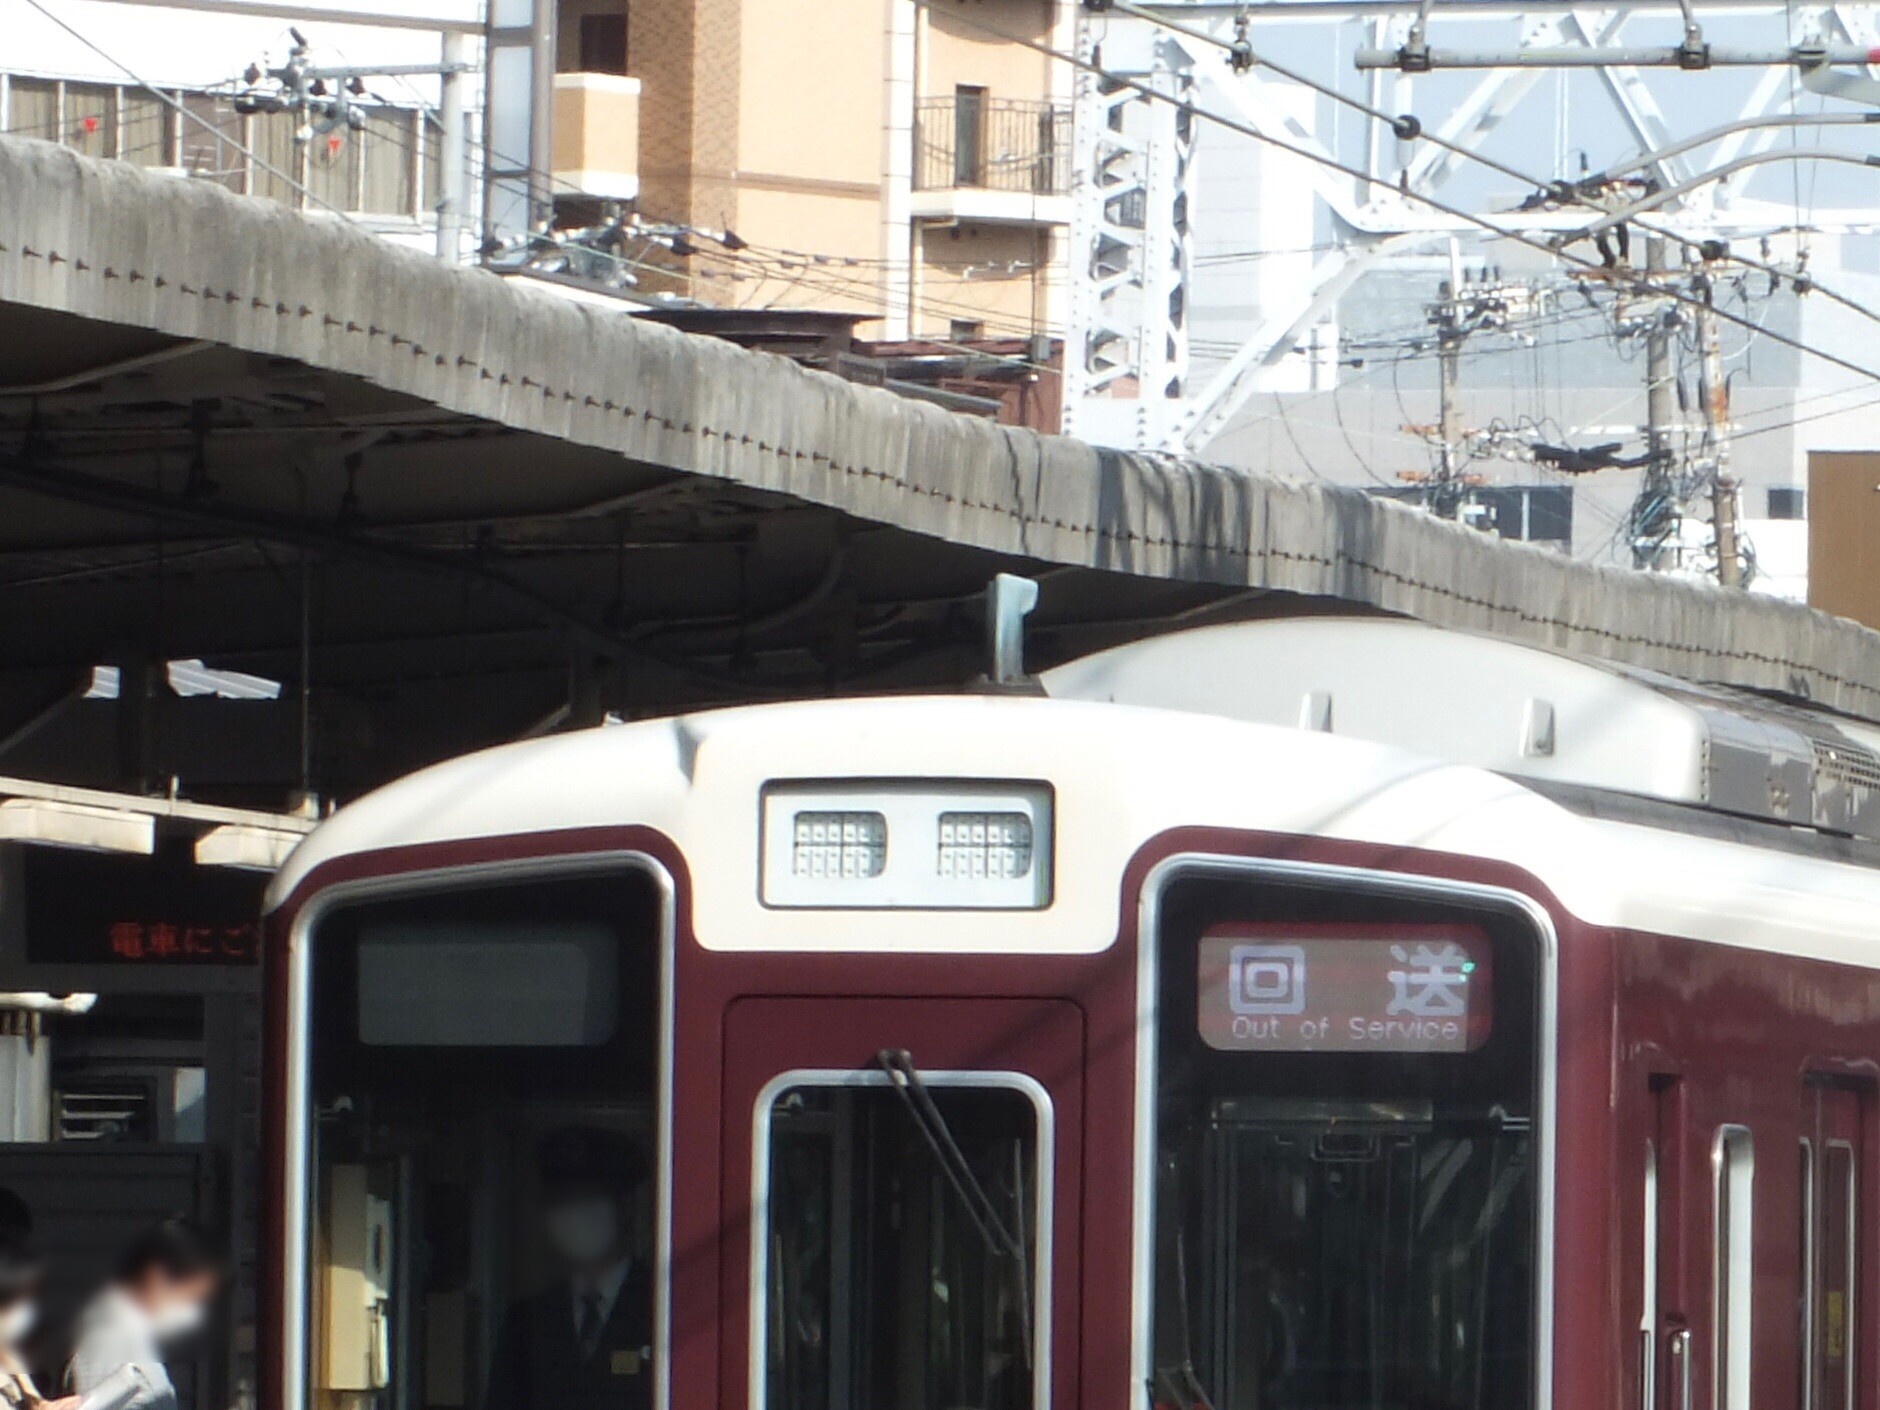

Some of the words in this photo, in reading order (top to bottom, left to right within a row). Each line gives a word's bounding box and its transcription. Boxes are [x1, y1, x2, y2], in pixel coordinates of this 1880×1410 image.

[1232, 1016, 1280, 1040] Out
[1300, 1015, 1329, 1040] of
[1349, 1016, 1459, 1041] Service
